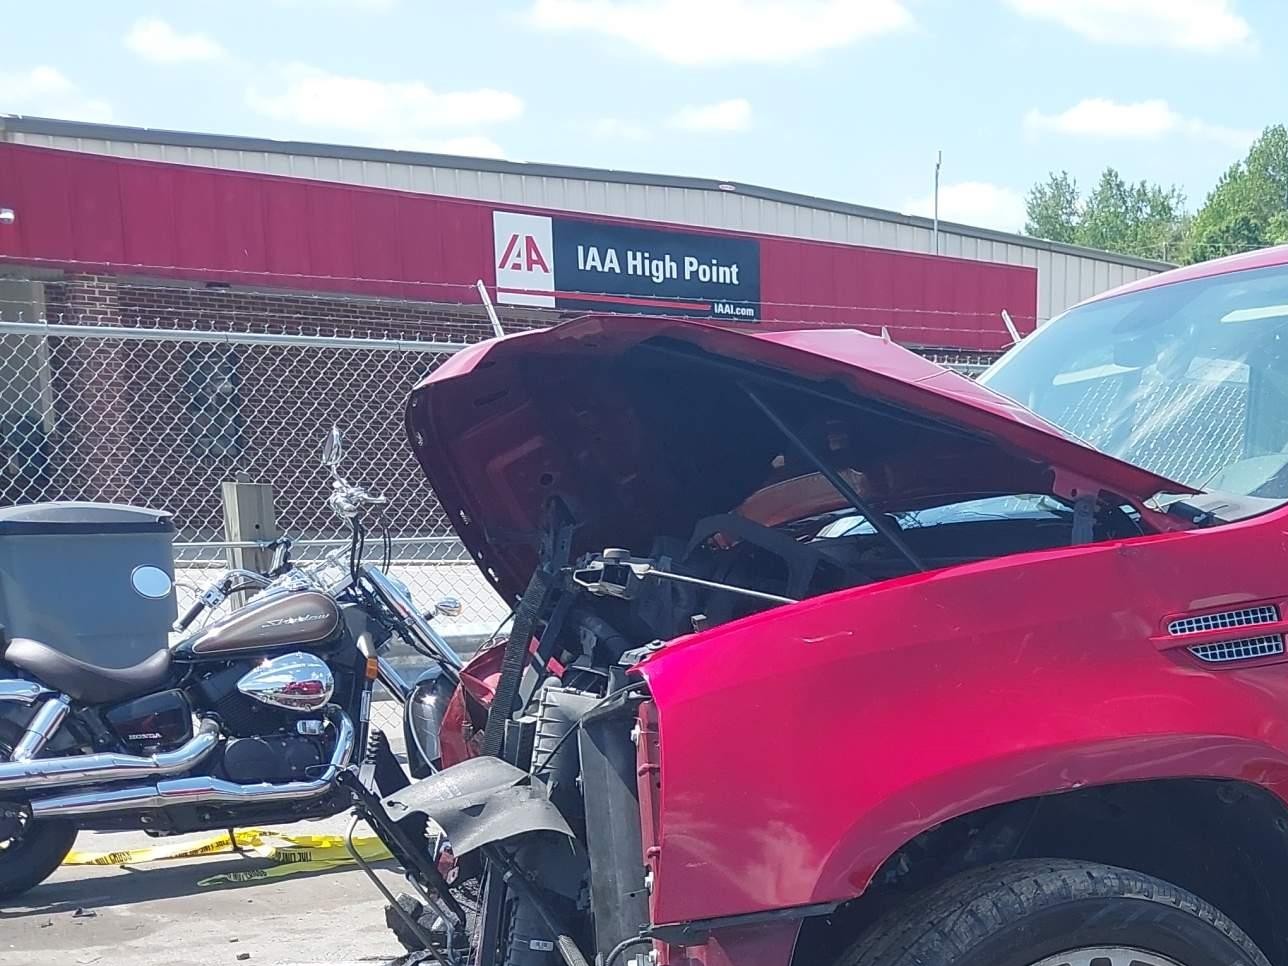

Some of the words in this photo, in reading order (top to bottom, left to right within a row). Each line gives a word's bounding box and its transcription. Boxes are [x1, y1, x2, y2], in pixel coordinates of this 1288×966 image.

[577, 245, 620, 273] IAA
[627, 250, 678, 283] High
[684, 256, 739, 285] Point
[714, 303, 754, 316] IAAI.com
